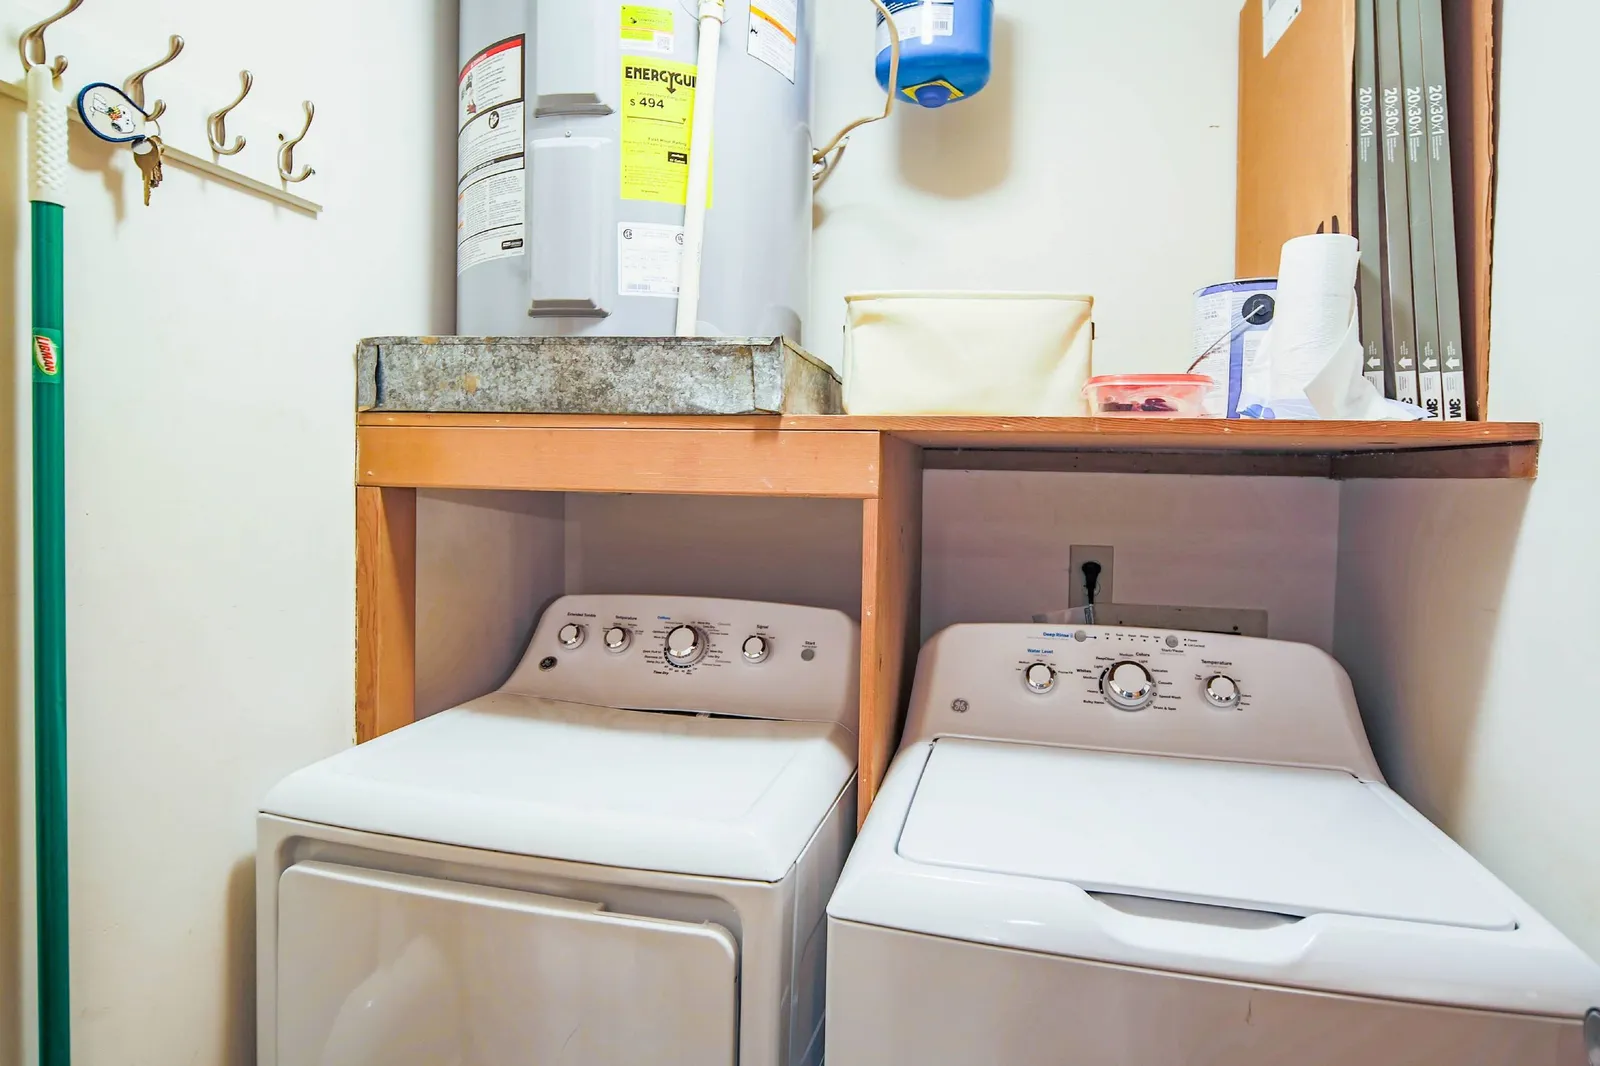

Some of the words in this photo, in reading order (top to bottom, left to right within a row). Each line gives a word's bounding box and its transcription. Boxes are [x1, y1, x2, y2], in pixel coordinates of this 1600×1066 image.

[625, 66, 697, 90] ENERGYGUI
[640, 97, 664, 108] 494
[36, 336, 55, 372] LIBMAN
[1426, 398, 1438, 418] 3M
[1449, 398, 1462, 418] 3M
